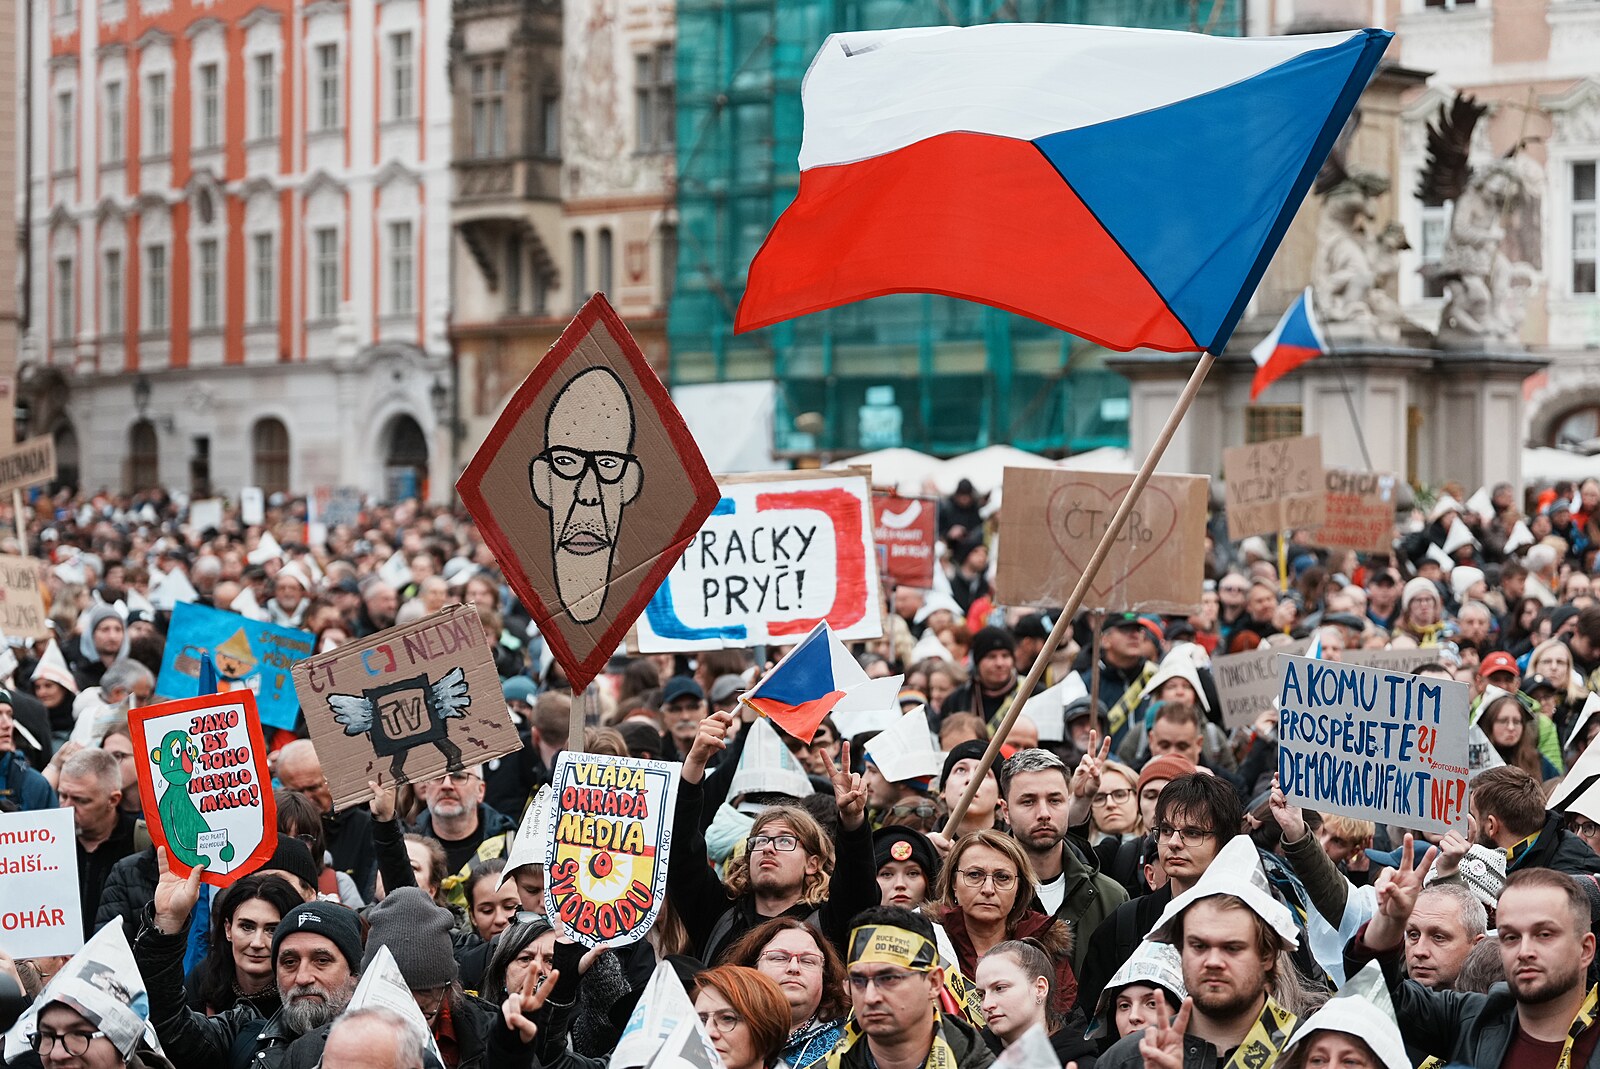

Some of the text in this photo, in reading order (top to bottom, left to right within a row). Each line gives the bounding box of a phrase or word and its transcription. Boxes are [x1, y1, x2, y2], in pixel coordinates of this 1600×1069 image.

[1063, 501, 1103, 540] ČT
[681, 525, 817, 571] PRACKY
[703, 565, 806, 617] PRYČ!
[304, 659, 338, 693] ČT
[1281, 661, 1303, 707] A
[1306, 663, 1379, 712] KOMU
[1384, 674, 1442, 724] TÍM
[189, 709, 239, 735] JAKO
[381, 697, 421, 735] TV
[201, 731, 229, 753] BY
[198, 746, 250, 772] TOHO
[573, 759, 646, 791] VLÁDA
[187, 768, 253, 795] NEBYLO
[200, 784, 260, 813] MÁLO!
[561, 785, 650, 819] OKRÁDÁ
[556, 812, 645, 855] MÉDIA
[550, 858, 654, 939] SVOBODU
[1, 905, 66, 931] OHÁR
[629, 909, 658, 941] STOJIME
[875, 943, 887, 951] OD
[876, 935, 894, 943] RUCE
